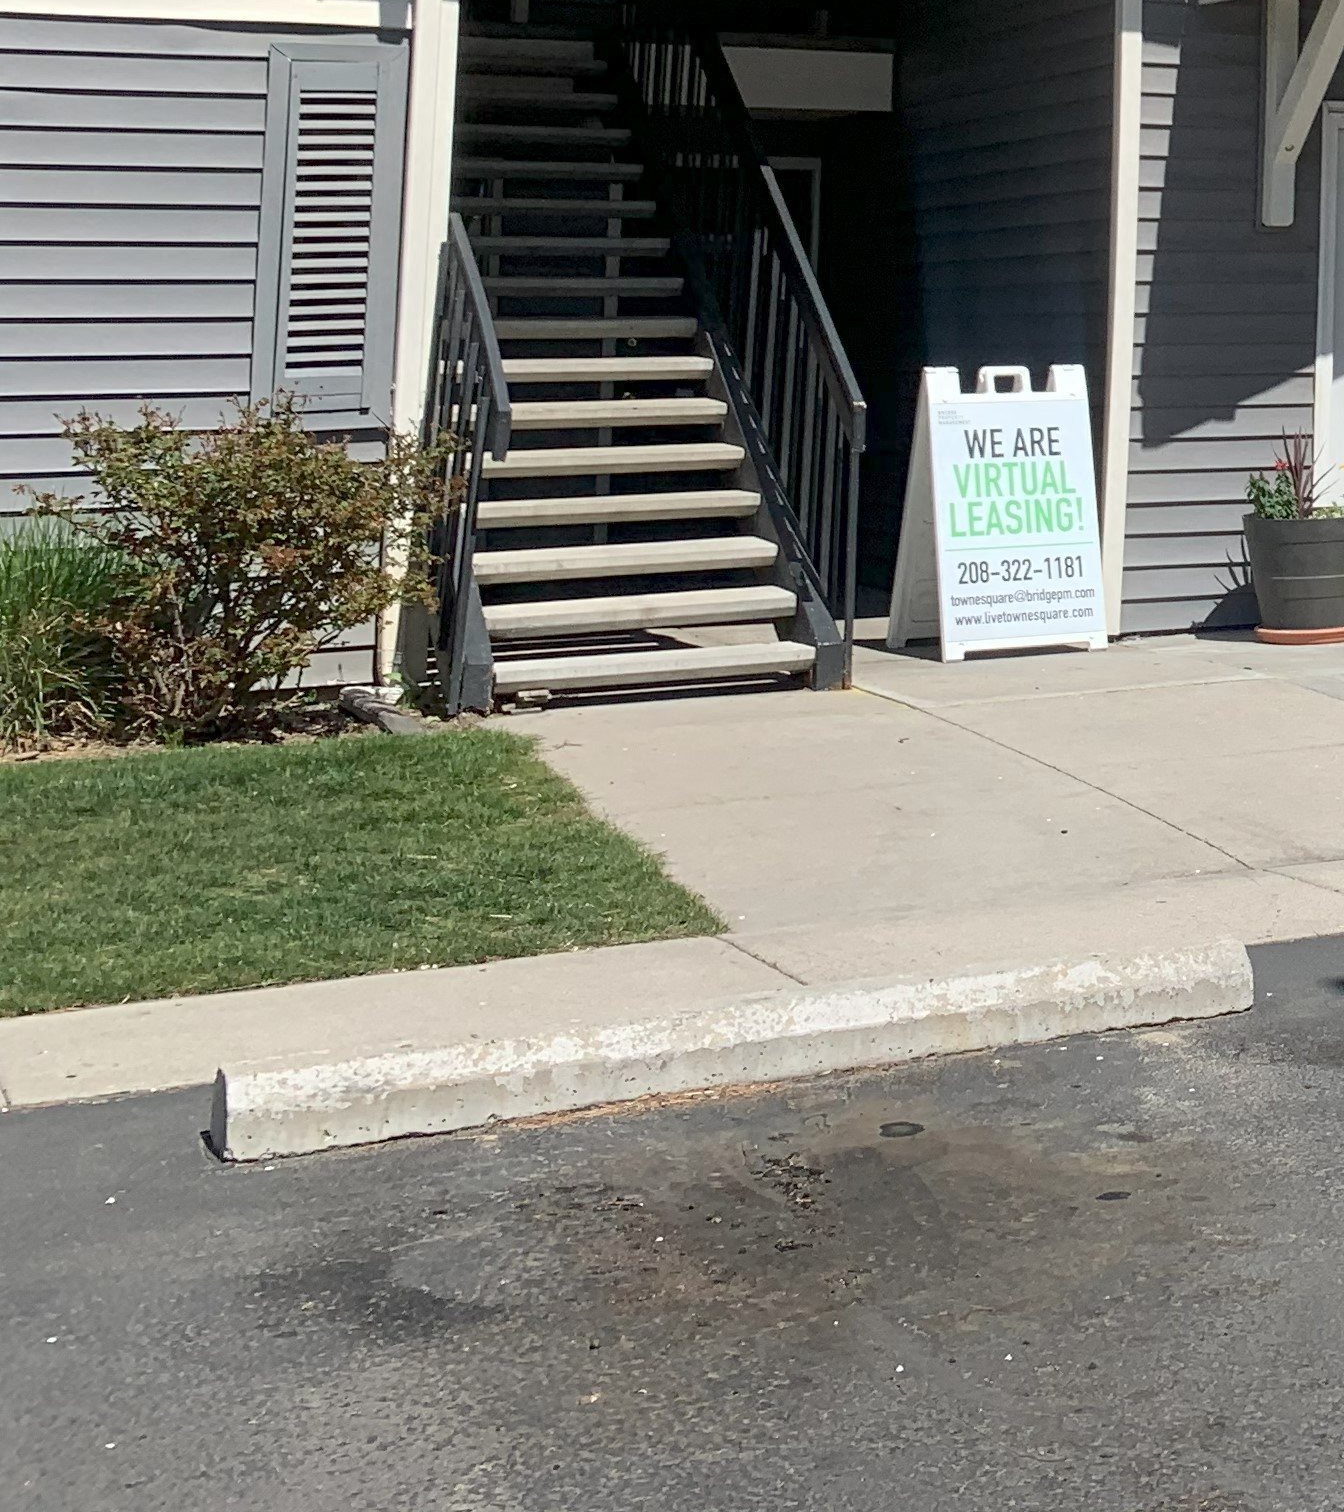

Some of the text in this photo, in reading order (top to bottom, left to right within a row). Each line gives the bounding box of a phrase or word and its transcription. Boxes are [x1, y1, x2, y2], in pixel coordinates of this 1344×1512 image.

[964, 426, 1061, 458] WE ARE
[952, 460, 1076, 498] VIRTUAL
[949, 497, 1085, 537] LEASING!
[957, 555, 1084, 585] 208-322-1181
[950, 587, 1095, 607] townesquare@bridgepm.com
[955, 607, 1094, 626] www.livetownesquare.com
